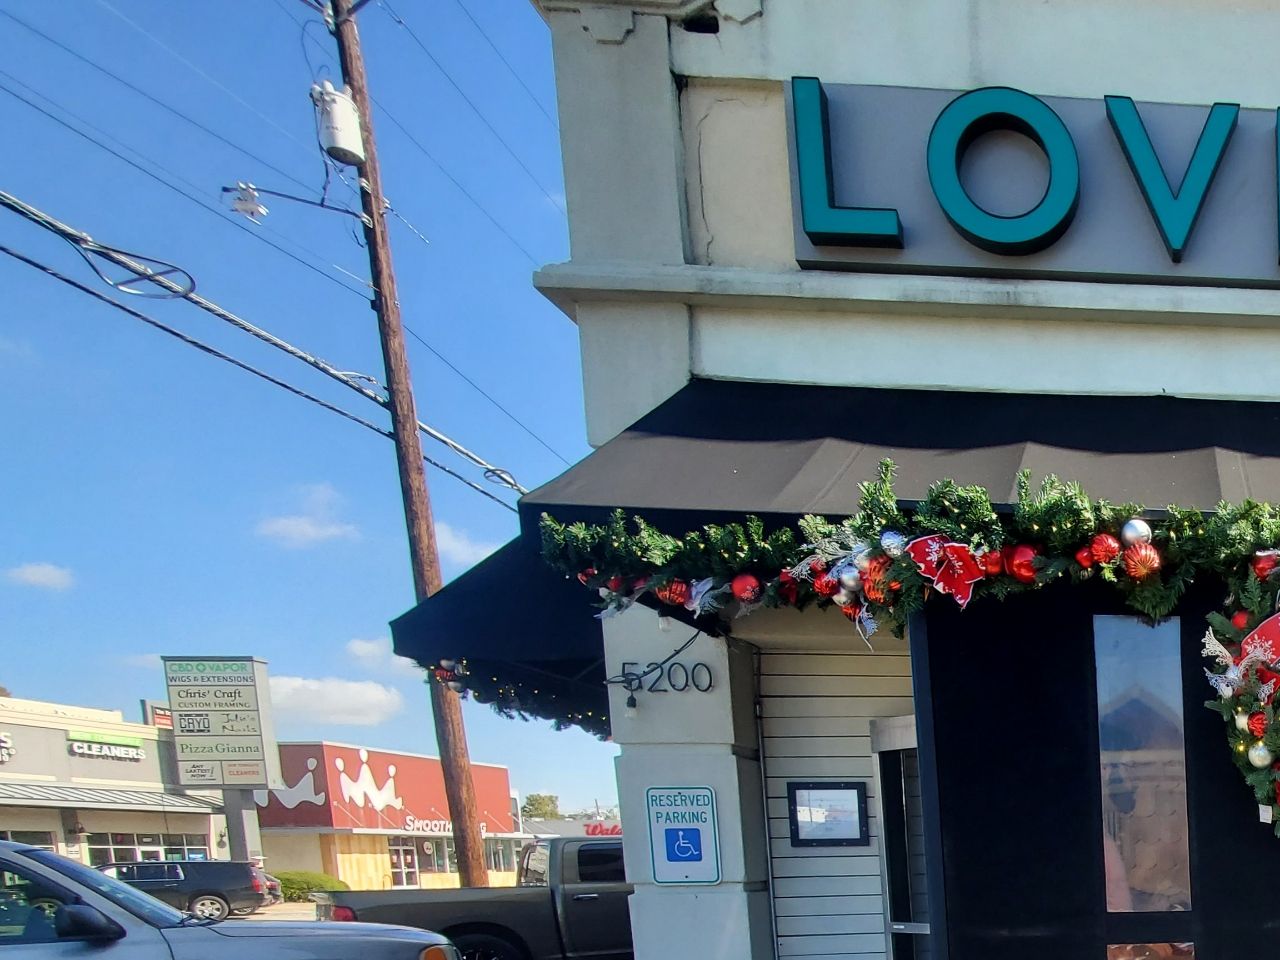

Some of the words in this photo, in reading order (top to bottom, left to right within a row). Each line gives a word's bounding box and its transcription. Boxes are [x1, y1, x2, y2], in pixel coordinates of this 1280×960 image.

[169, 662, 193, 673] CBD
[209, 662, 248, 672] VAPOR
[169, 675, 192, 683] WIGS
[201, 675, 255, 683] EXTENSIONS
[621, 662, 713, 692] 5200
[178, 689, 210, 699] Chris'
[214, 688, 242, 701] Craft
[179, 717, 211, 729] CRYO
[72, 742, 146, 759] CLEANERS
[180, 743, 214, 754] Pizza
[215, 743, 260, 754] Gianna
[650, 794, 710, 807] RESERVED
[404, 815, 453, 833] SMOOTH
[655, 811, 708, 824] PARKING
[583, 822, 623, 836] Wal
